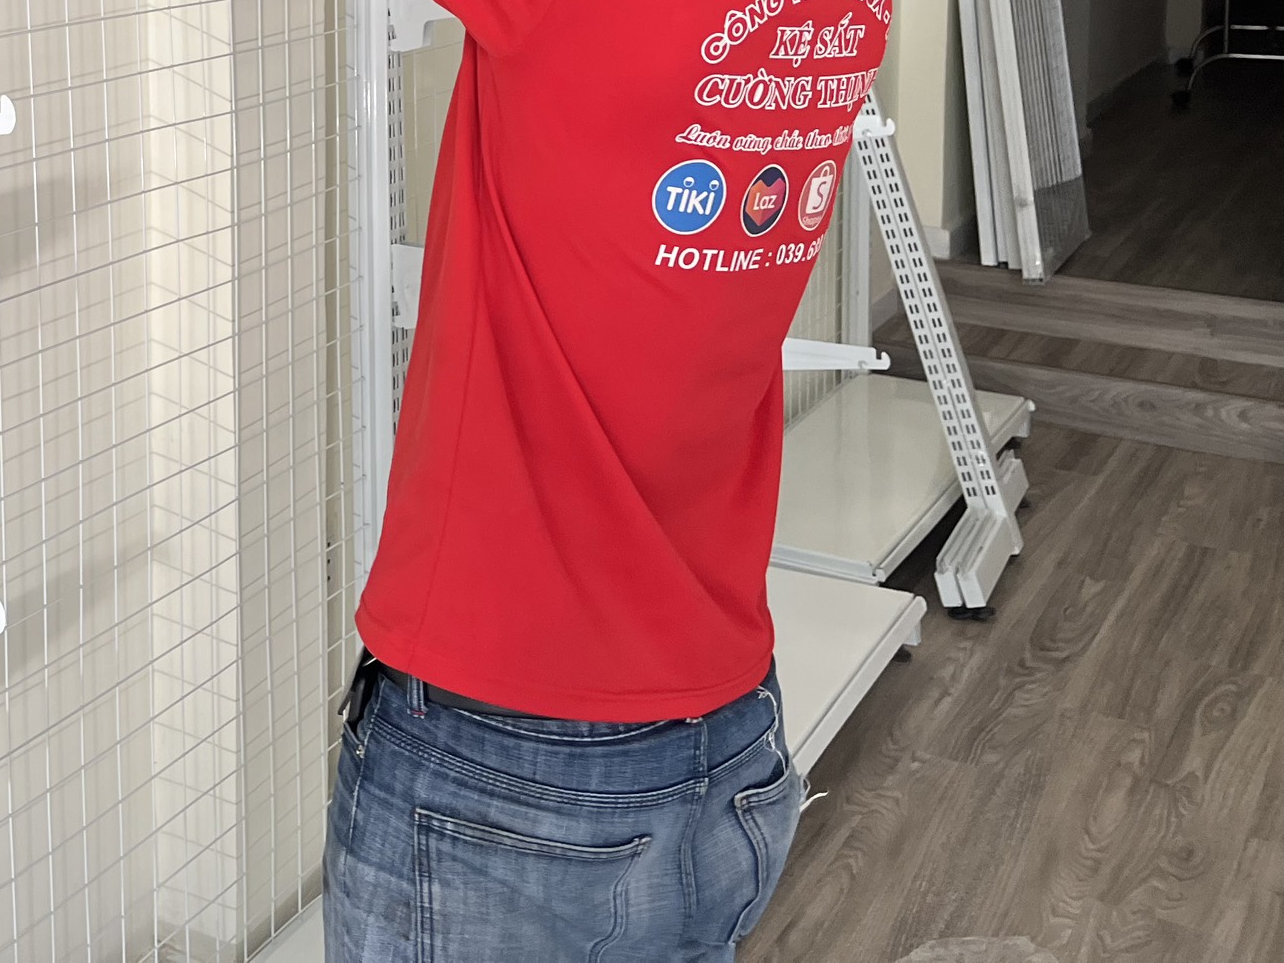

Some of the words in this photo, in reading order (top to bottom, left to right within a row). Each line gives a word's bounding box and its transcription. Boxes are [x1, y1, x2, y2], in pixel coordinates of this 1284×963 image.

[769, 20, 814, 67] KỆ
[813, 12, 865, 59] SẮT
[694, 68, 812, 110] CƯỜNG
[675, 123, 731, 149] Luôn
[753, 191, 776, 211] Laz
[655, 244, 764, 272] HOTLINE
